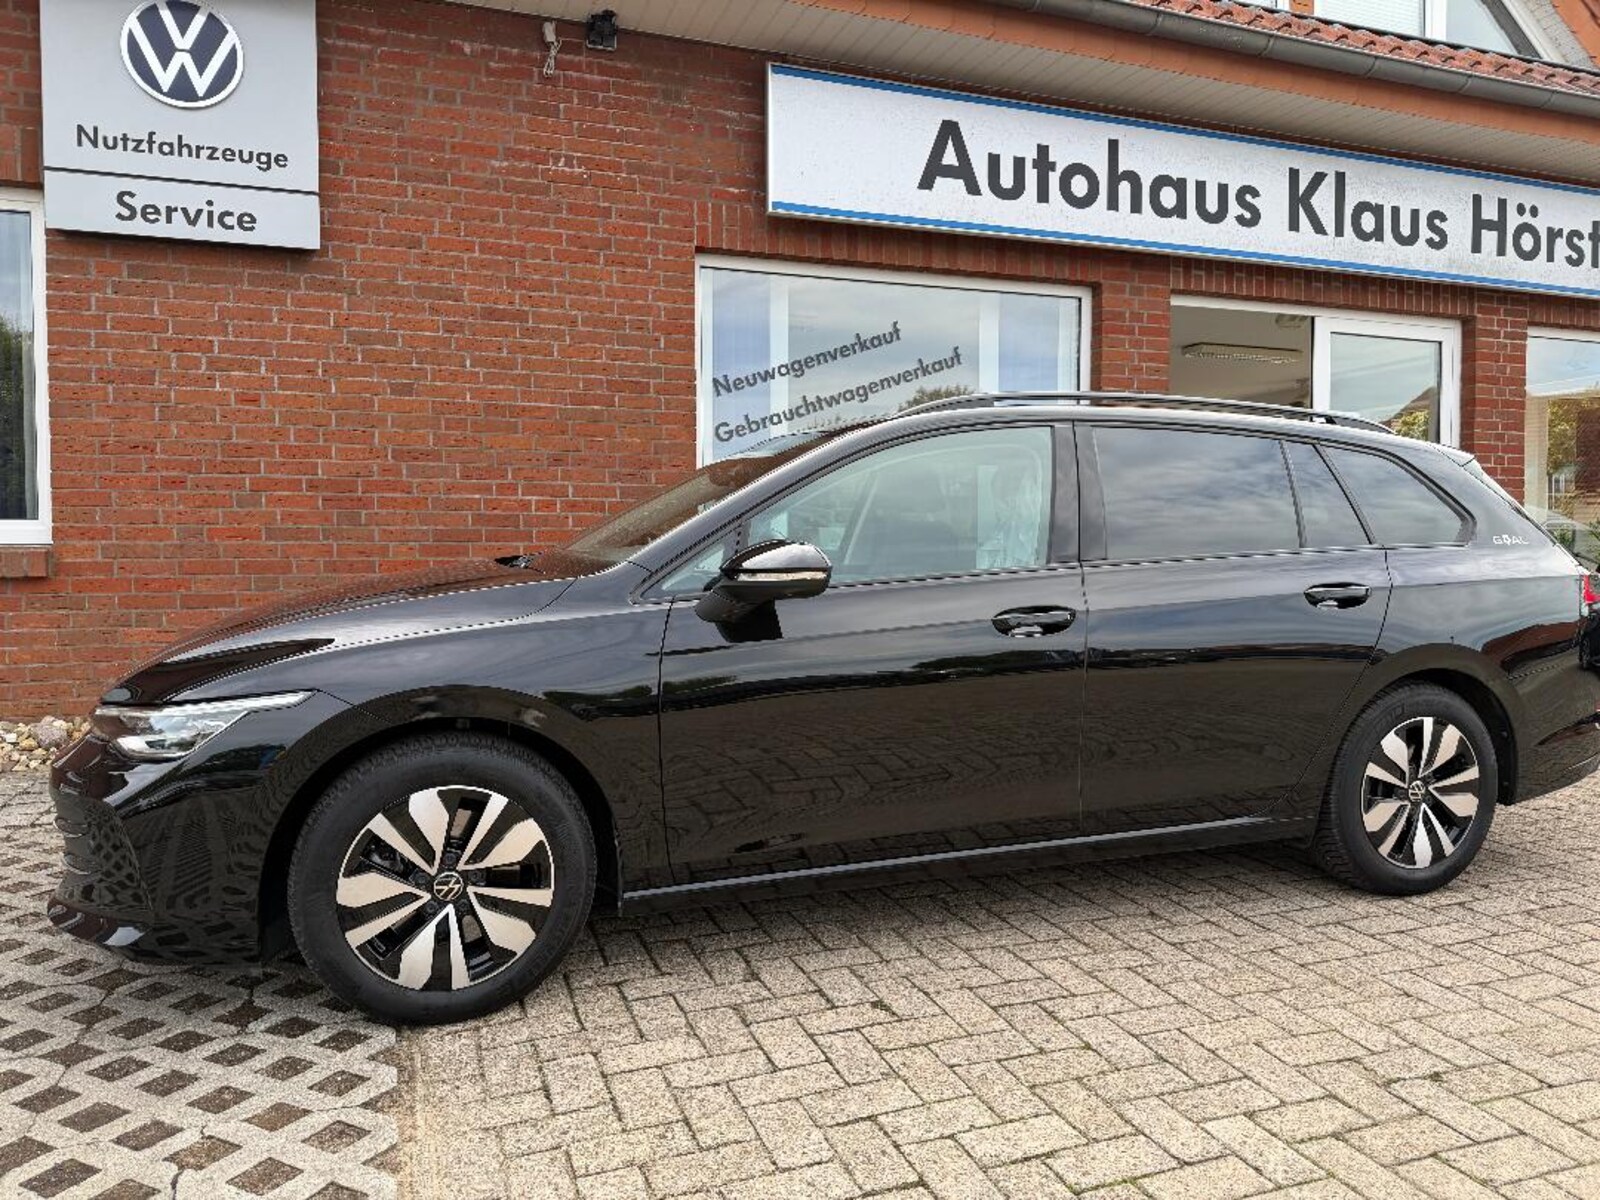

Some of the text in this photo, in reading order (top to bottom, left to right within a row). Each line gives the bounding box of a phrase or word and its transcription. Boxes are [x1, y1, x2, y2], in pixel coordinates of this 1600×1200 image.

[76, 124, 289, 172] Nutzfahrzeuge
[918, 119, 1261, 228] Autohaus
[1288, 167, 1448, 250] Klaus
[115, 190, 257, 232] Service
[711, 321, 902, 397] Neuwagenverkauf
[714, 346, 963, 443] Gebrauchtwagenverkauf
